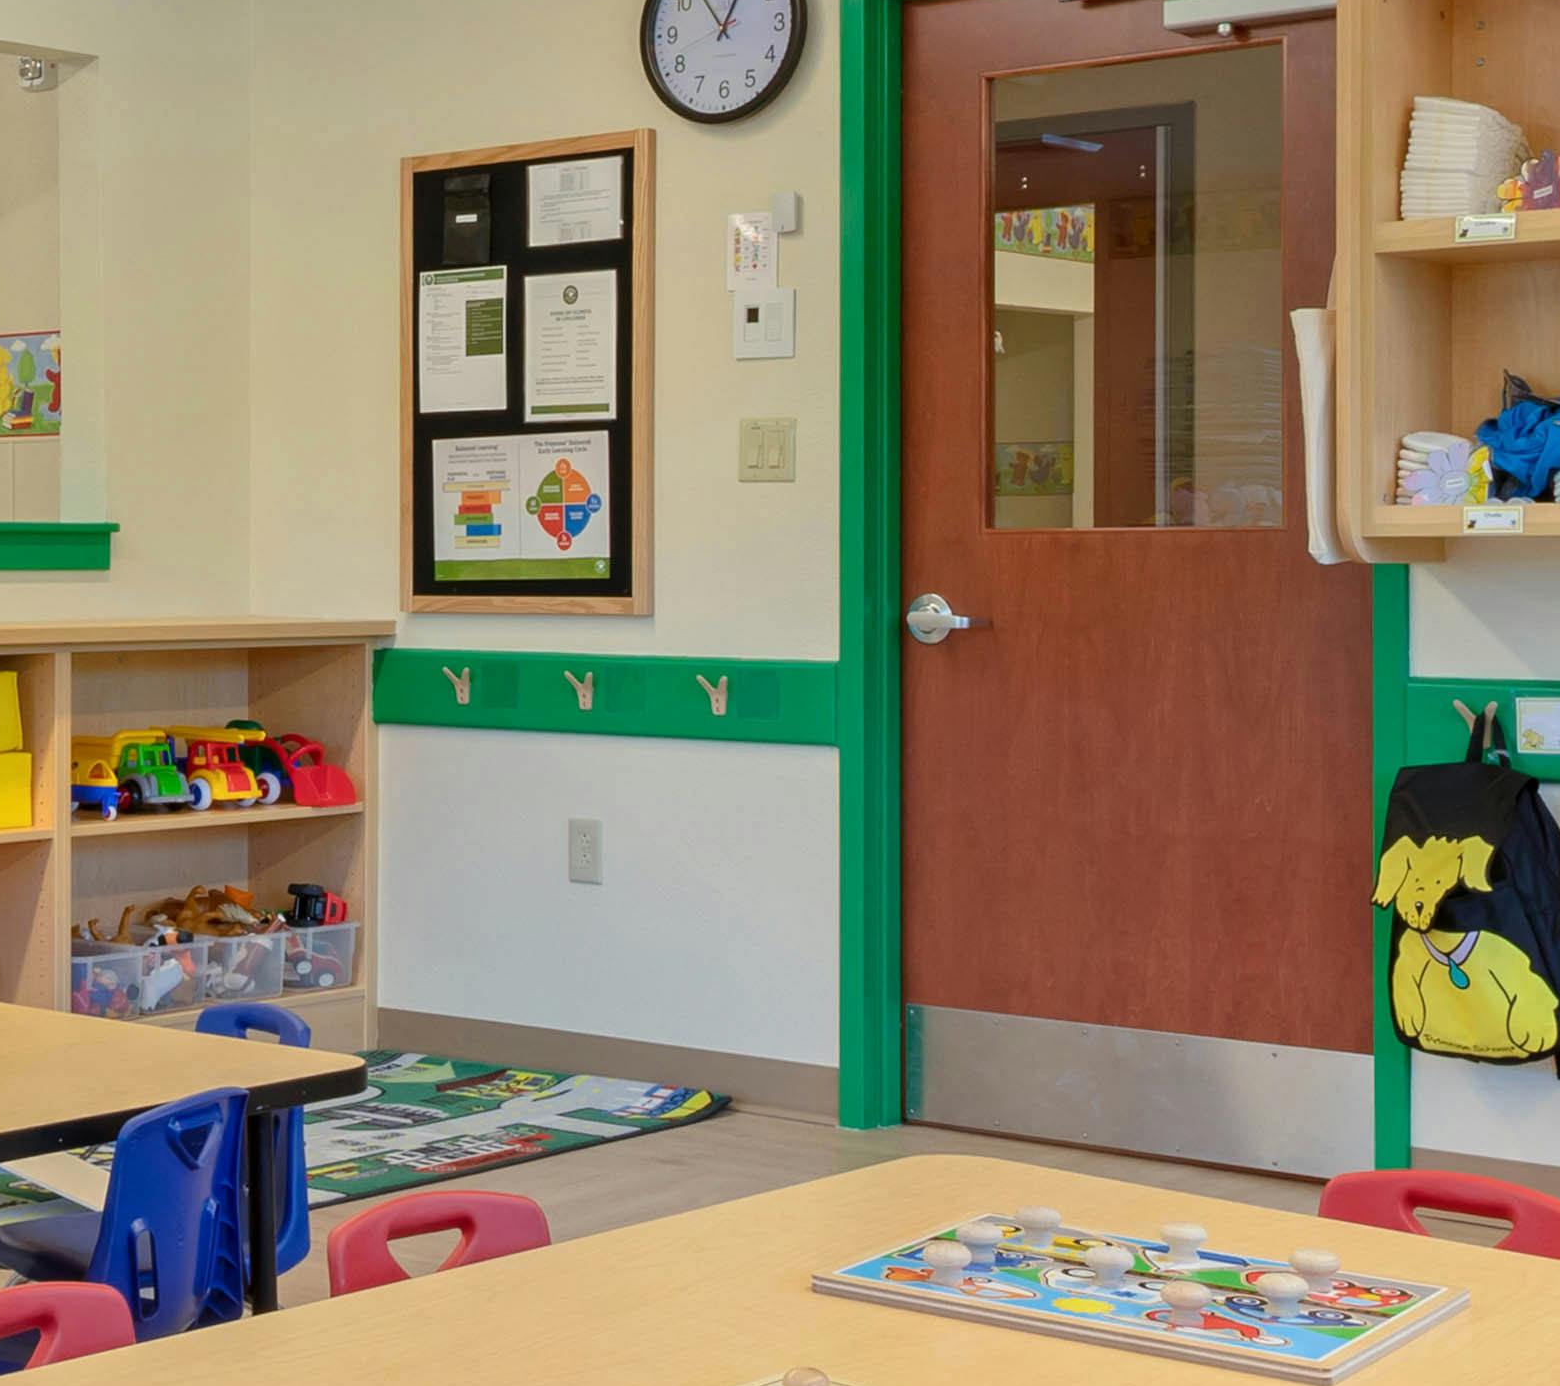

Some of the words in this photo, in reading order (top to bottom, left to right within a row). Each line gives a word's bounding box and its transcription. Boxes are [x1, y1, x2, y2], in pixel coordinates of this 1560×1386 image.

[774, 12, 785, 32] 3
[667, 26, 678, 45] 9
[674, 54, 686, 73] 8
[765, 45, 776, 63] 4
[694, 76, 705, 94] 7
[745, 69, 756, 88] 5
[718, 80, 730, 99] 6
[1423, 1034, 1472, 1051] Primrose
